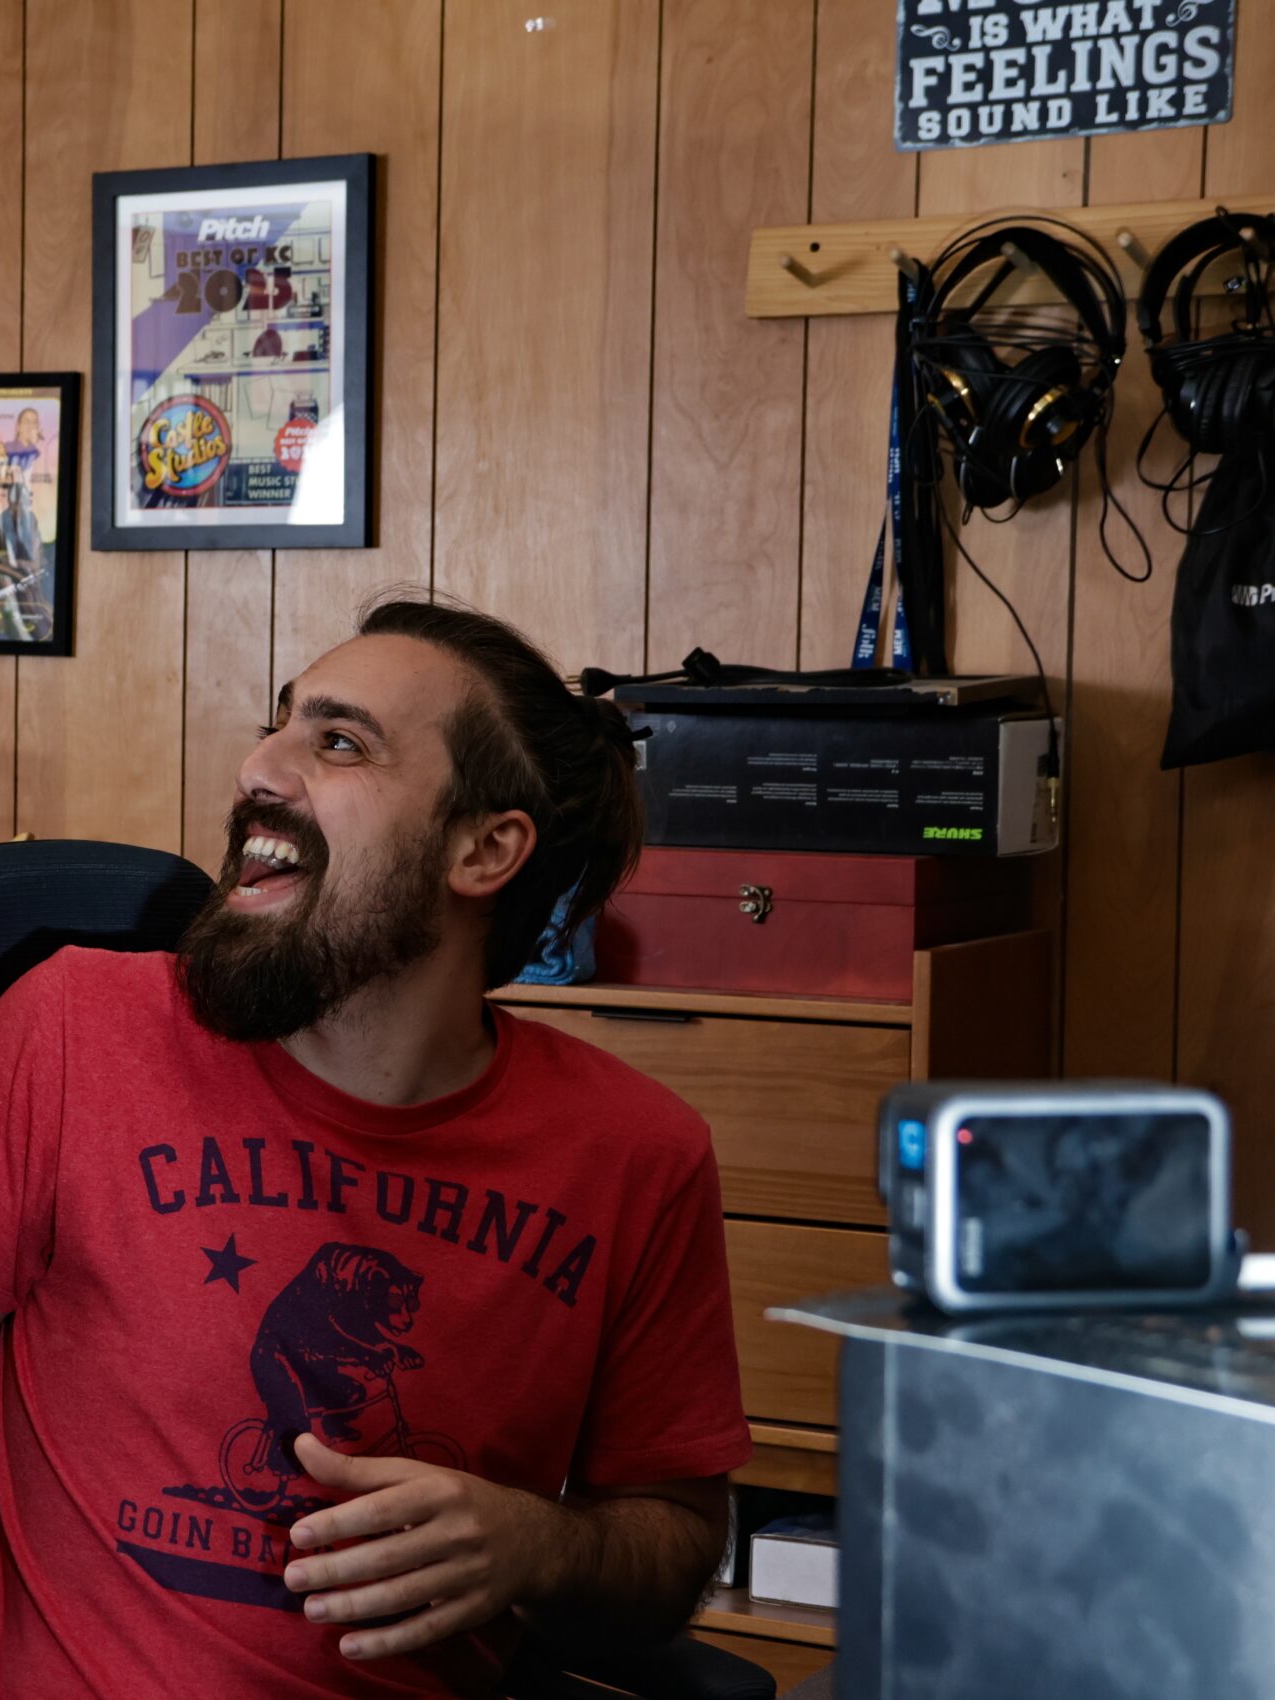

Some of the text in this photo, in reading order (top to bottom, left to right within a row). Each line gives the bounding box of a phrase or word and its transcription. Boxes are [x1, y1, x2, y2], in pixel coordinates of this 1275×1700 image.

[968, 0, 1162, 49] IS WHAT
[909, 25, 1221, 108] FEELINGS
[918, 84, 1208, 140] SOUND LIKE
[197, 215, 270, 243] Pitch
[176, 245, 292, 268] BEST OF KC
[175, 266, 292, 314] 2025
[149, 411, 214, 449] Castle
[146, 436, 226, 489] Studios
[248, 464, 271, 475] BEST
[248, 475, 281, 487] MUSIC
[248, 488, 291, 499] WINNER
[923, 827, 984, 840] SHURE
[139, 1136, 598, 1308] CALIFORNIA
[117, 1499, 214, 1551] GOIN
